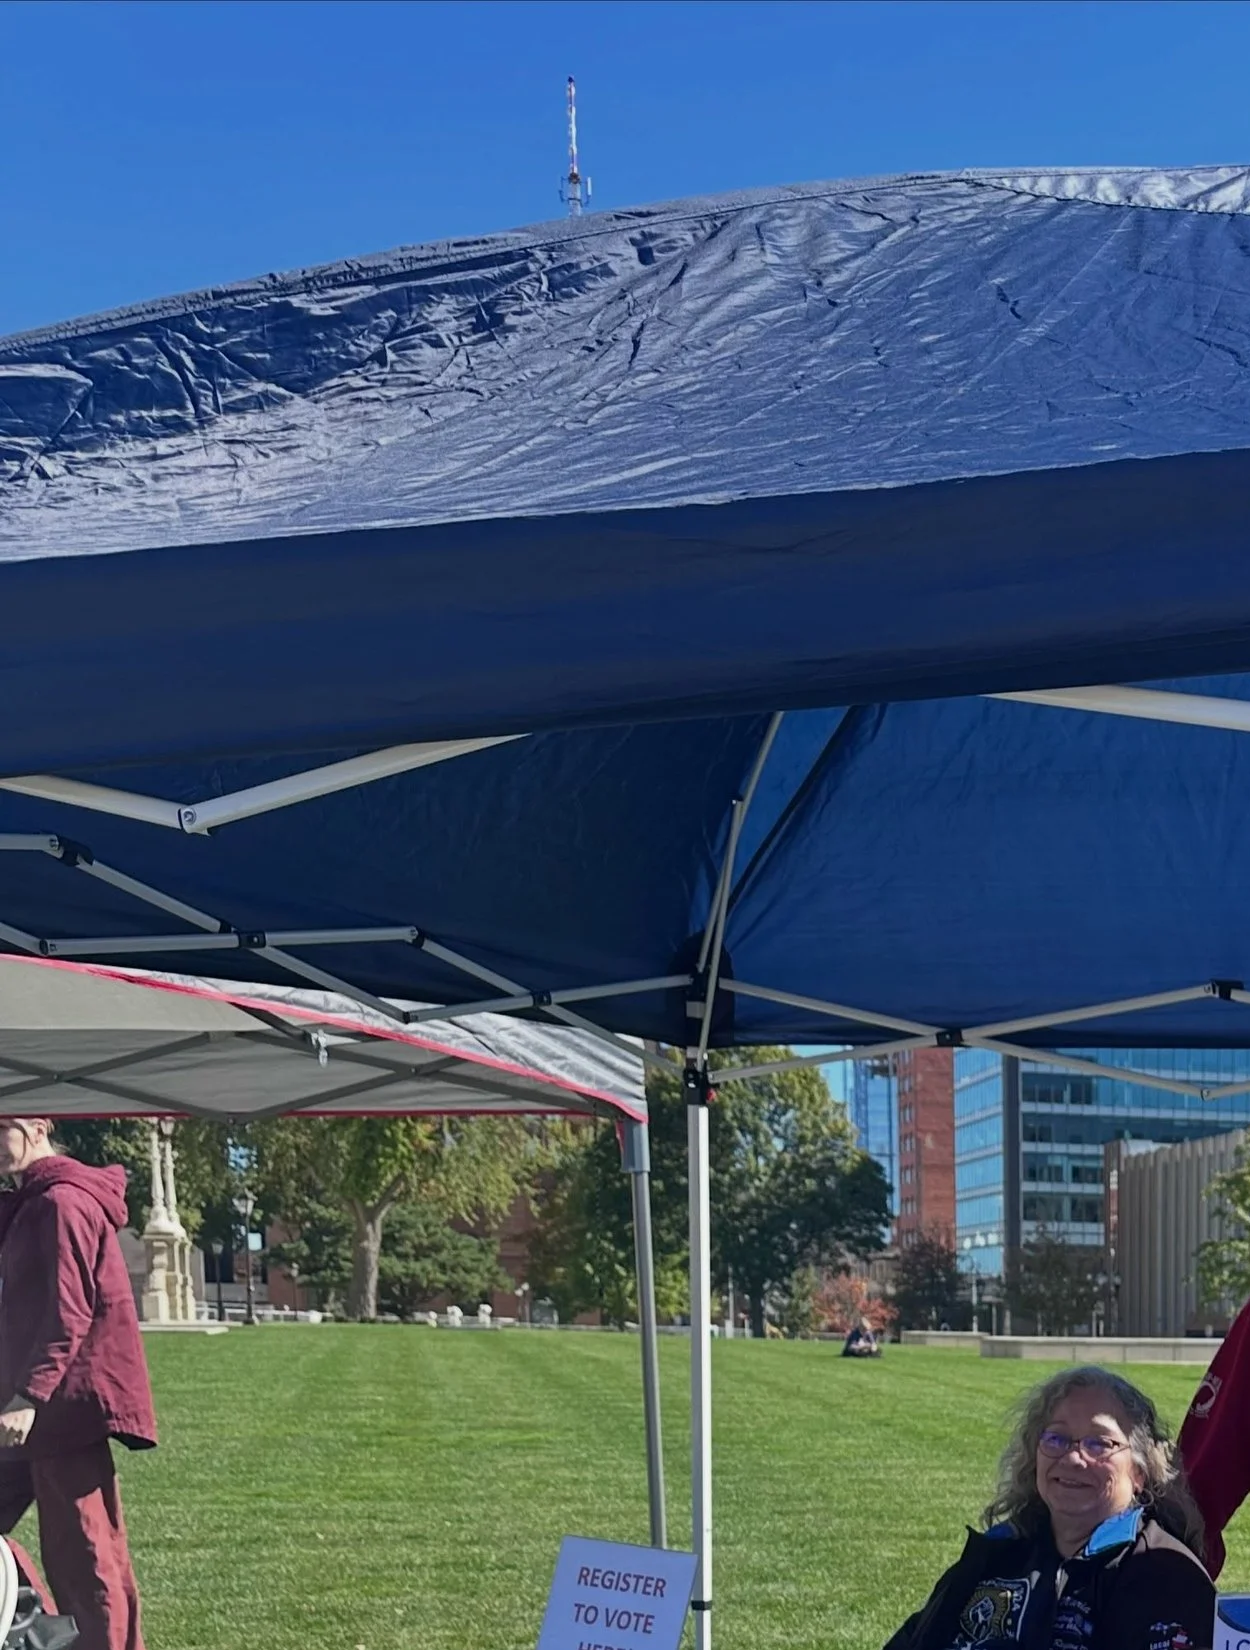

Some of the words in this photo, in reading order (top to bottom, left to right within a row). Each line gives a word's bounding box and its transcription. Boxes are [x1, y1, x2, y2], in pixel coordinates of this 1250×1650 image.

[577, 1566, 667, 1599] REGISTER
[573, 1602, 599, 1625] TO
[605, 1607, 656, 1635] VOTE
